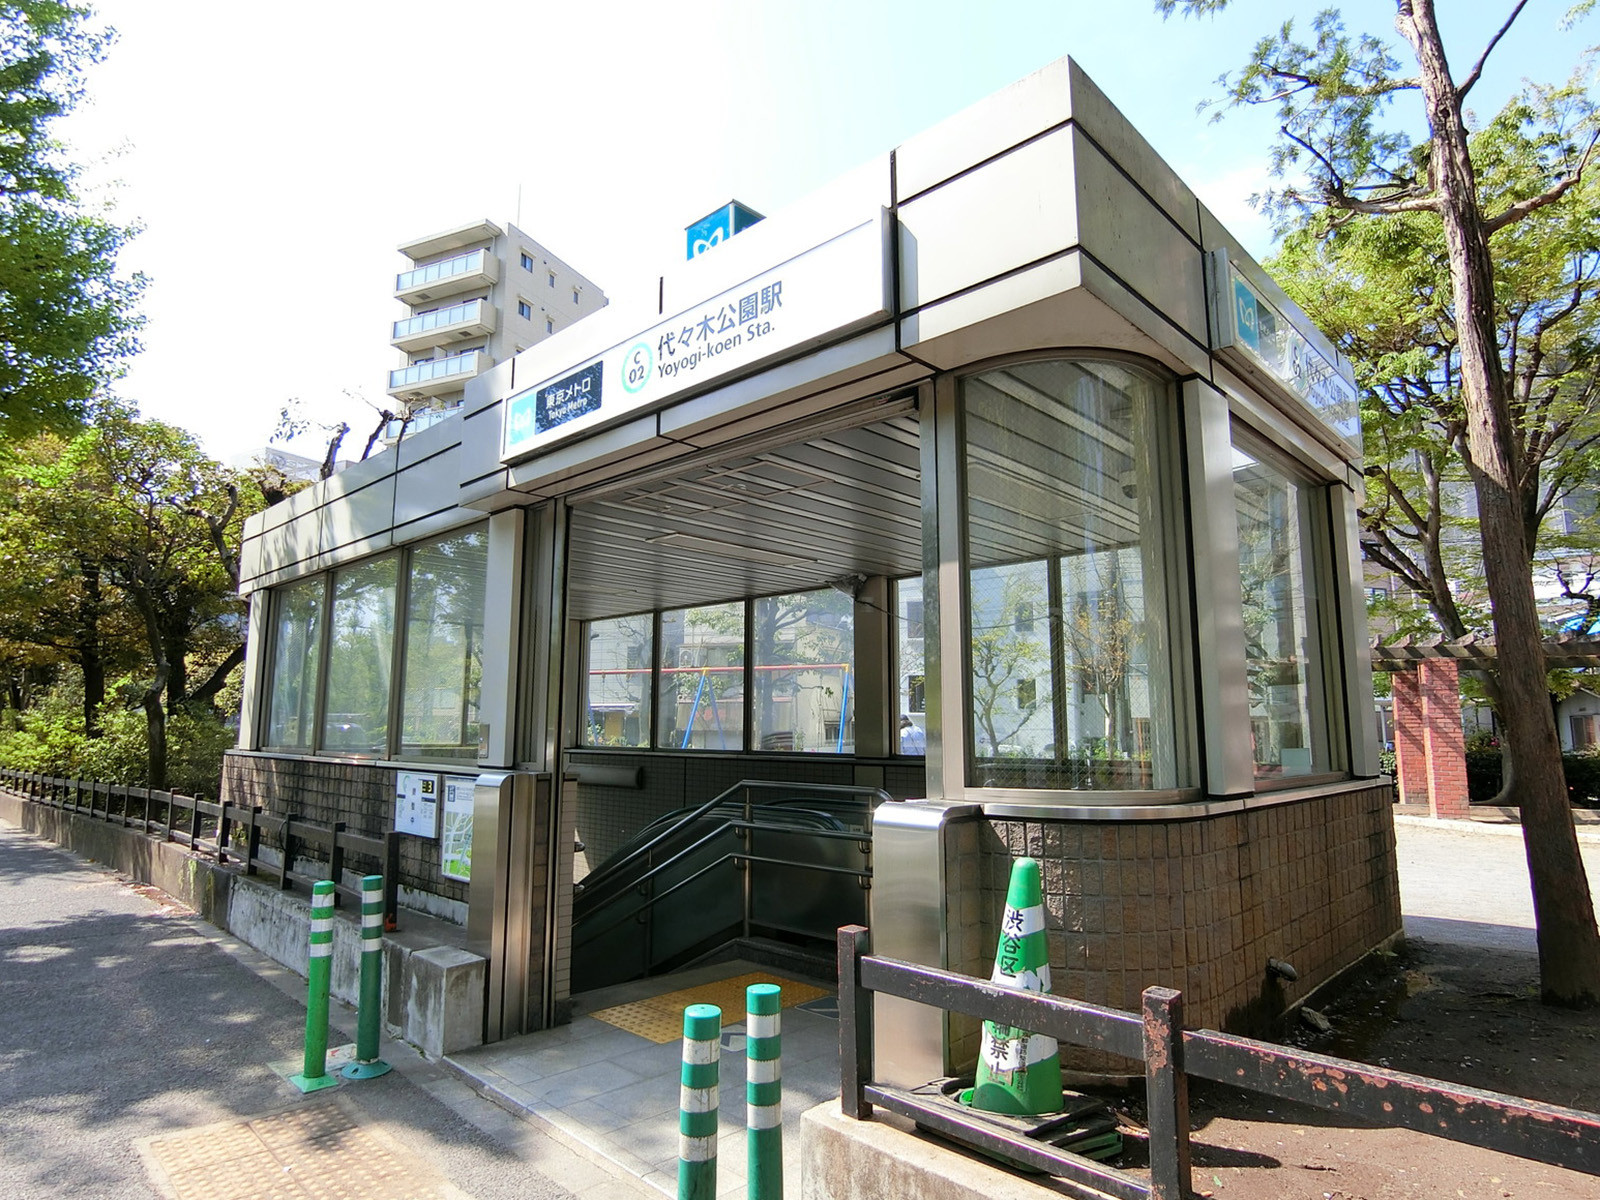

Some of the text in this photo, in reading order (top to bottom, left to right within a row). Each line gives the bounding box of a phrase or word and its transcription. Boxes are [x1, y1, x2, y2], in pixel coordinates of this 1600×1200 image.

[658, 280, 783, 361] 代々木公園駅
[633, 350, 641, 365] C
[658, 320, 775, 378] Yoyogi-koen Sta.
[628, 364, 645, 384] 02
[544, 377, 591, 410] 東京メトロ
[548, 397, 588, 421] Tokyo Metro
[1000, 909, 1025, 979] 渋谷区
